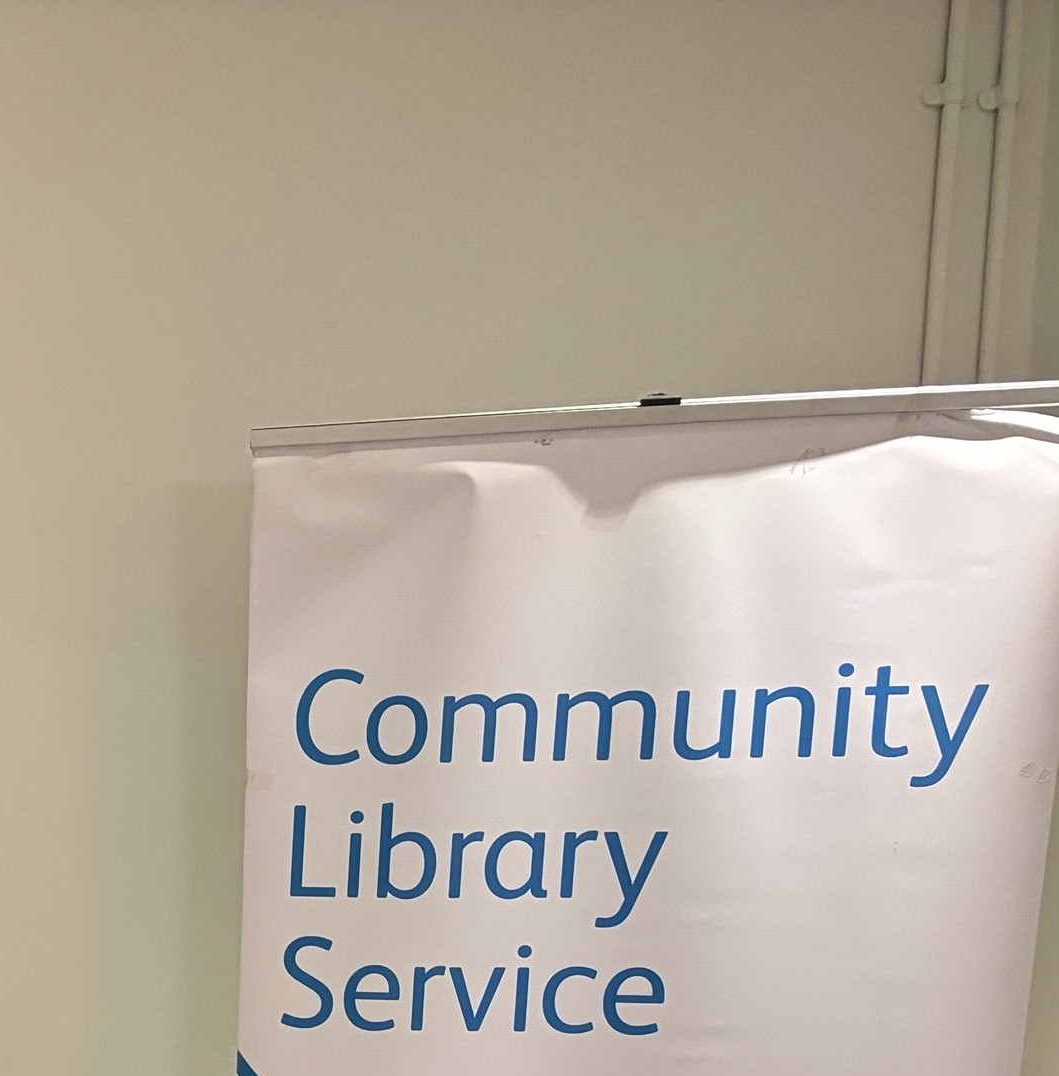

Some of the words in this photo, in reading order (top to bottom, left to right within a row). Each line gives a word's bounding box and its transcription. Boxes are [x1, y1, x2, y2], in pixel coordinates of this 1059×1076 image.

[295, 662, 990, 788] Community
[289, 802, 669, 928] Library
[280, 936, 665, 1035] Service
